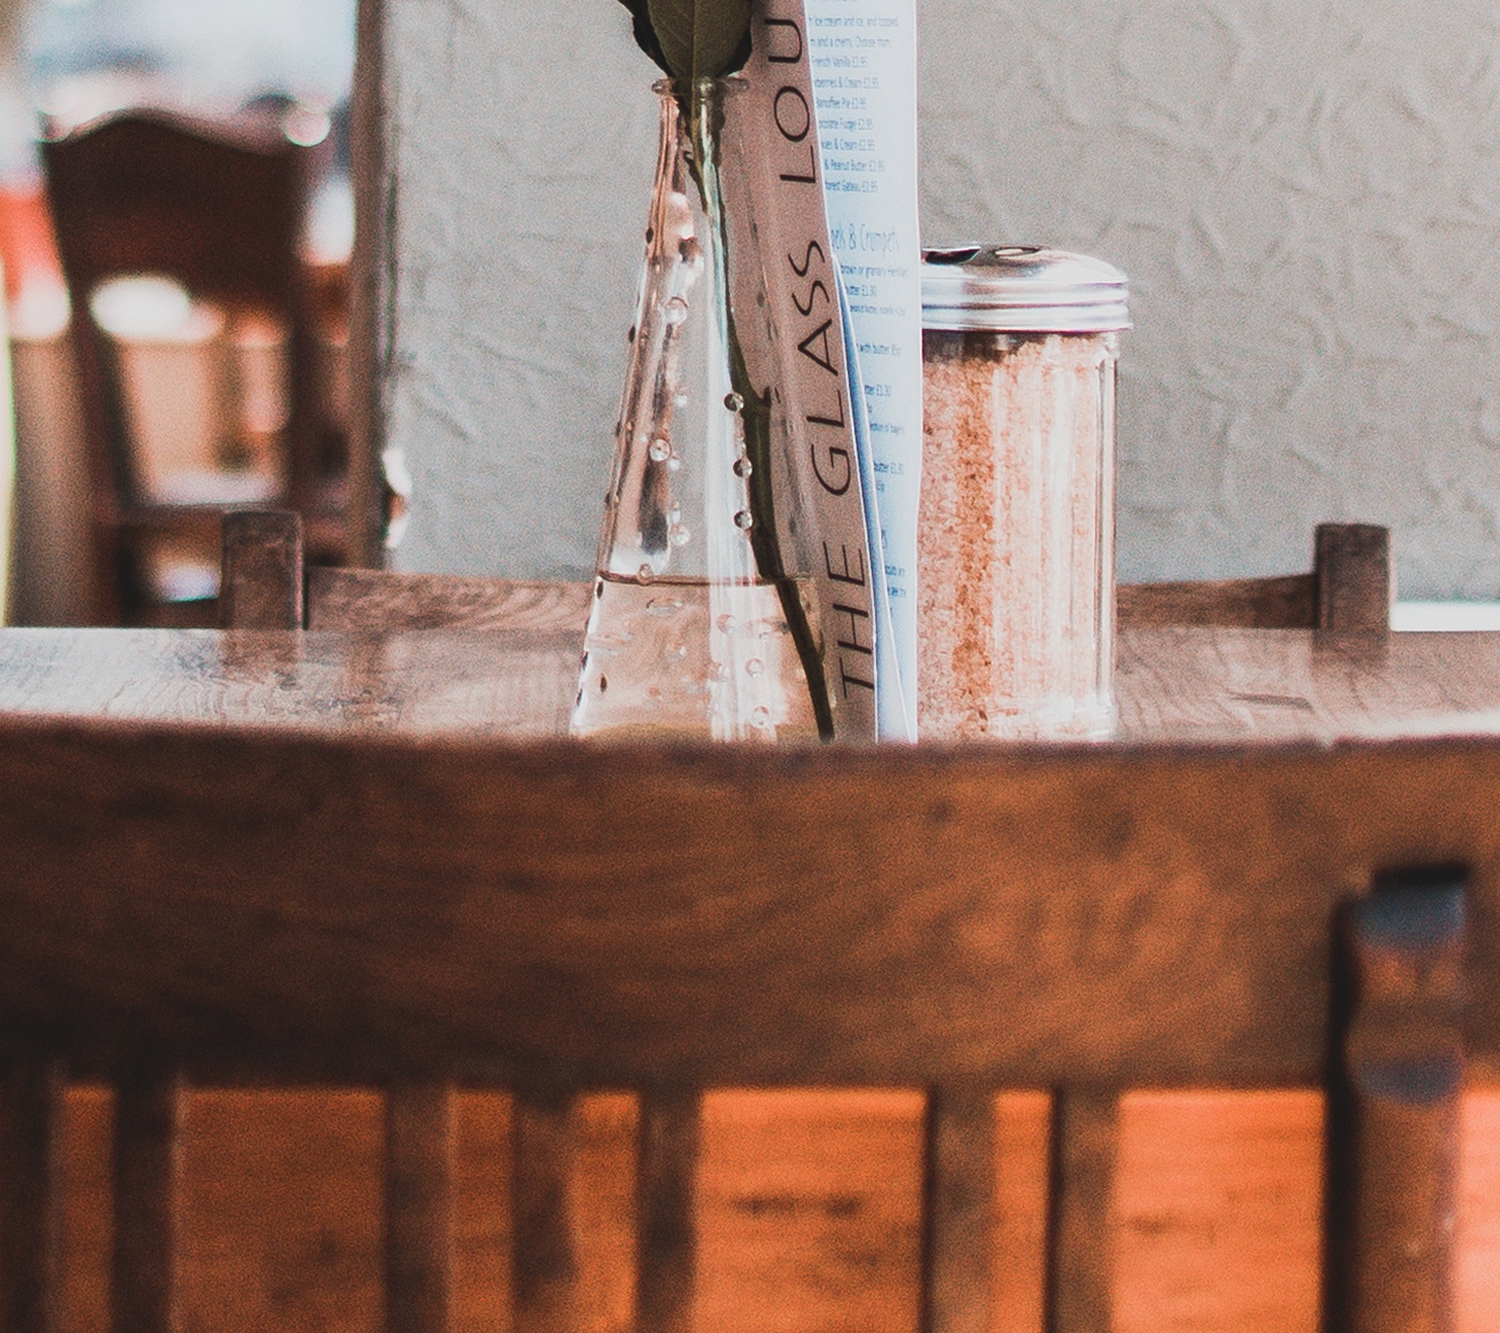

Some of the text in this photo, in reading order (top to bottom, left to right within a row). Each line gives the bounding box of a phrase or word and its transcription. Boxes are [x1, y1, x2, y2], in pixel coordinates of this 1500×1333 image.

[848, 222, 857, 250] &
[860, 223, 901, 261] Crumpets
[788, 240, 851, 496] GLASS
[821, 540, 874, 699] THE
